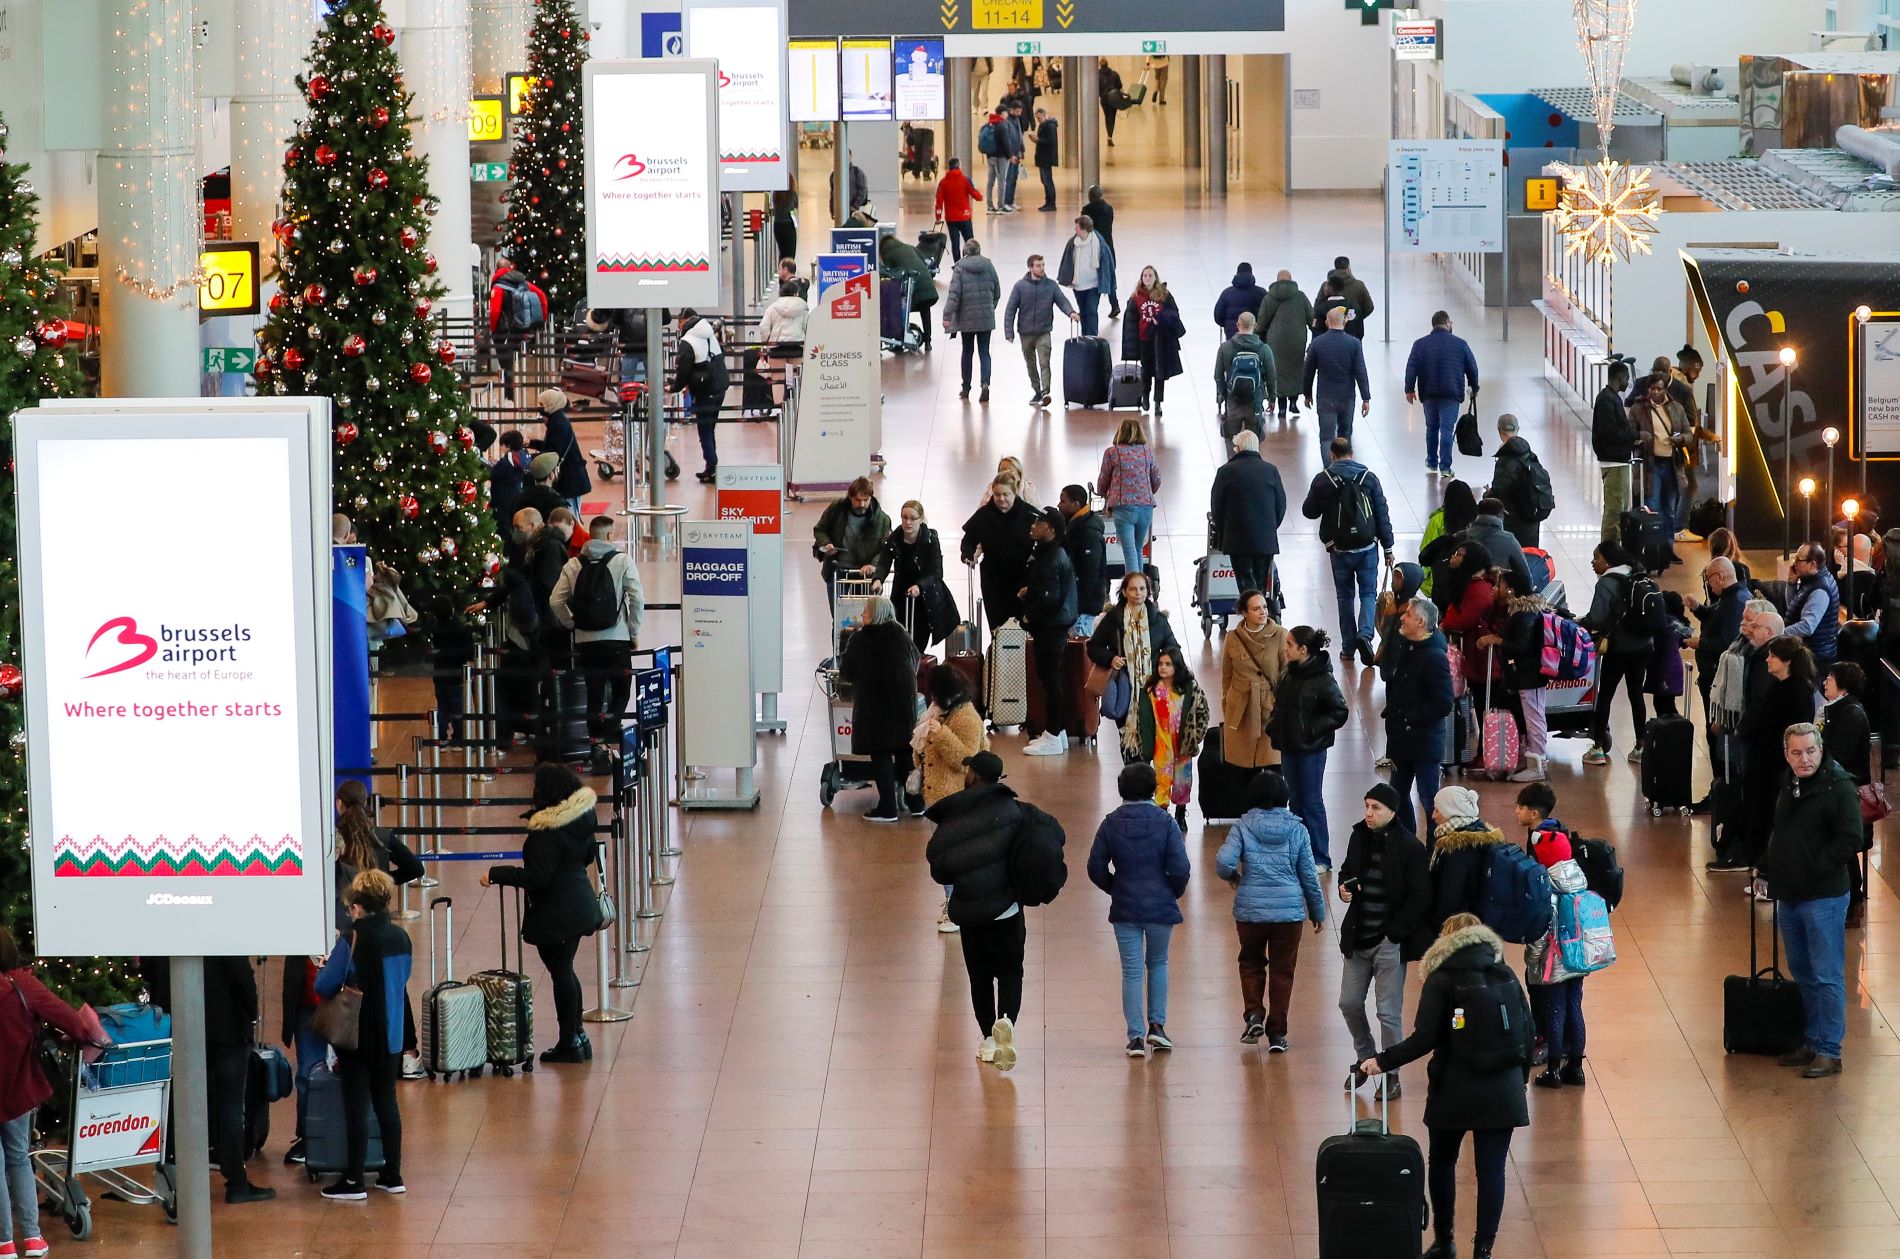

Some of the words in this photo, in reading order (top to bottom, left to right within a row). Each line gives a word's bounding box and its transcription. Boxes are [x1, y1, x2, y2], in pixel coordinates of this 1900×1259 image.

[984, 10, 1031, 25] 11-14
[472, 115, 497, 134] 09
[646, 156, 688, 165] brussels
[647, 166, 681, 176] airport
[634, 191, 672, 200] together
[675, 191, 701, 199] starts
[208, 272, 245, 300] 07
[820, 352, 863, 360] BUSINESS
[820, 360, 849, 368] CLASS
[1868, 413, 1889, 421] CASH
[721, 507, 744, 517] SKY
[686, 562, 744, 572] BAGGAGE
[686, 572, 742, 582] DROP-OFF
[160, 623, 252, 642] brussels
[162, 644, 237, 666] airport
[146, 670, 164, 680] the
[167, 670, 197, 680] heart
[200, 669, 211, 680] of
[214, 670, 254, 681] Europe
[64, 702, 127, 718] Where
[133, 700, 219, 721] together
[225, 702, 282, 717] starts
[79, 1113, 150, 1139] corendon
